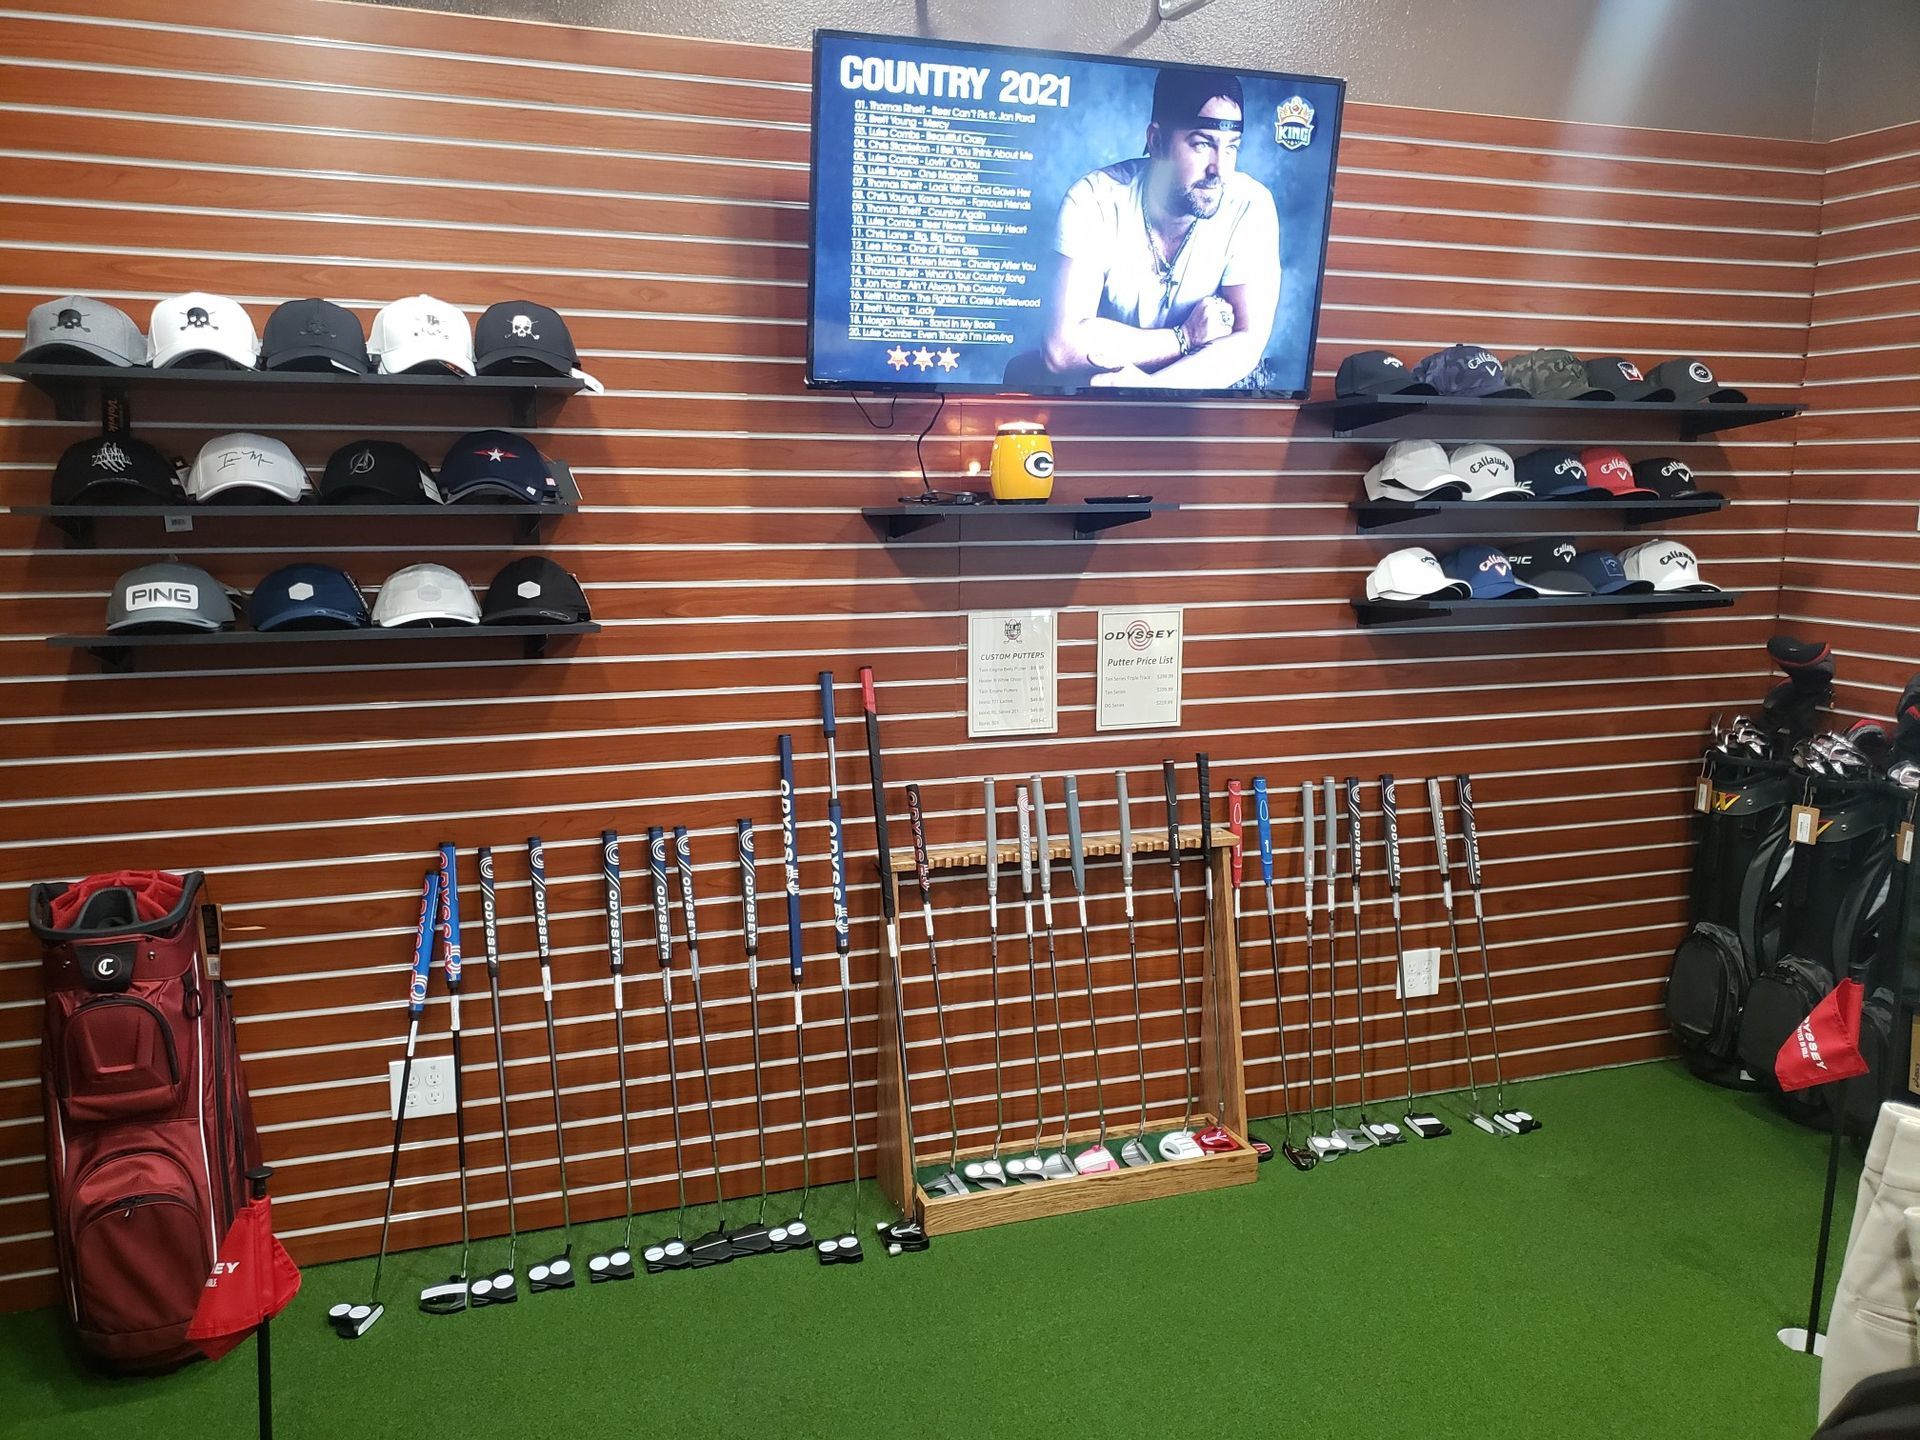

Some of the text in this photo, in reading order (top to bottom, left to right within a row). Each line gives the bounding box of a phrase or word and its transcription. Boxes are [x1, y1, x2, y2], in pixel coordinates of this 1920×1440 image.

[840, 55, 1071, 107] COUNTRY 2021
[1279, 126, 1309, 142] KING
[1470, 456, 1509, 473] Callaway
[1508, 556, 1532, 564] PIC
[131, 588, 191, 605] PING
[1105, 629, 1175, 640] ODYSSEY
[1107, 655, 1173, 667] Putter Price List
[1390, 824, 1401, 879] ODYSSEY
[1439, 811, 1448, 857] ODYSSEY
[1470, 822, 1481, 877] ODYSSEY
[535, 890, 549, 952] ODYSSEY
[609, 890, 621, 956] ODYSSEY
[656, 885, 670, 952] ODYSSEY
[682, 876, 696, 935] ODYSSEY
[744, 875, 756, 941] ODYSSEY
[484, 901, 497, 964] ODYSSEY
[212, 1261, 240, 1275] EY
